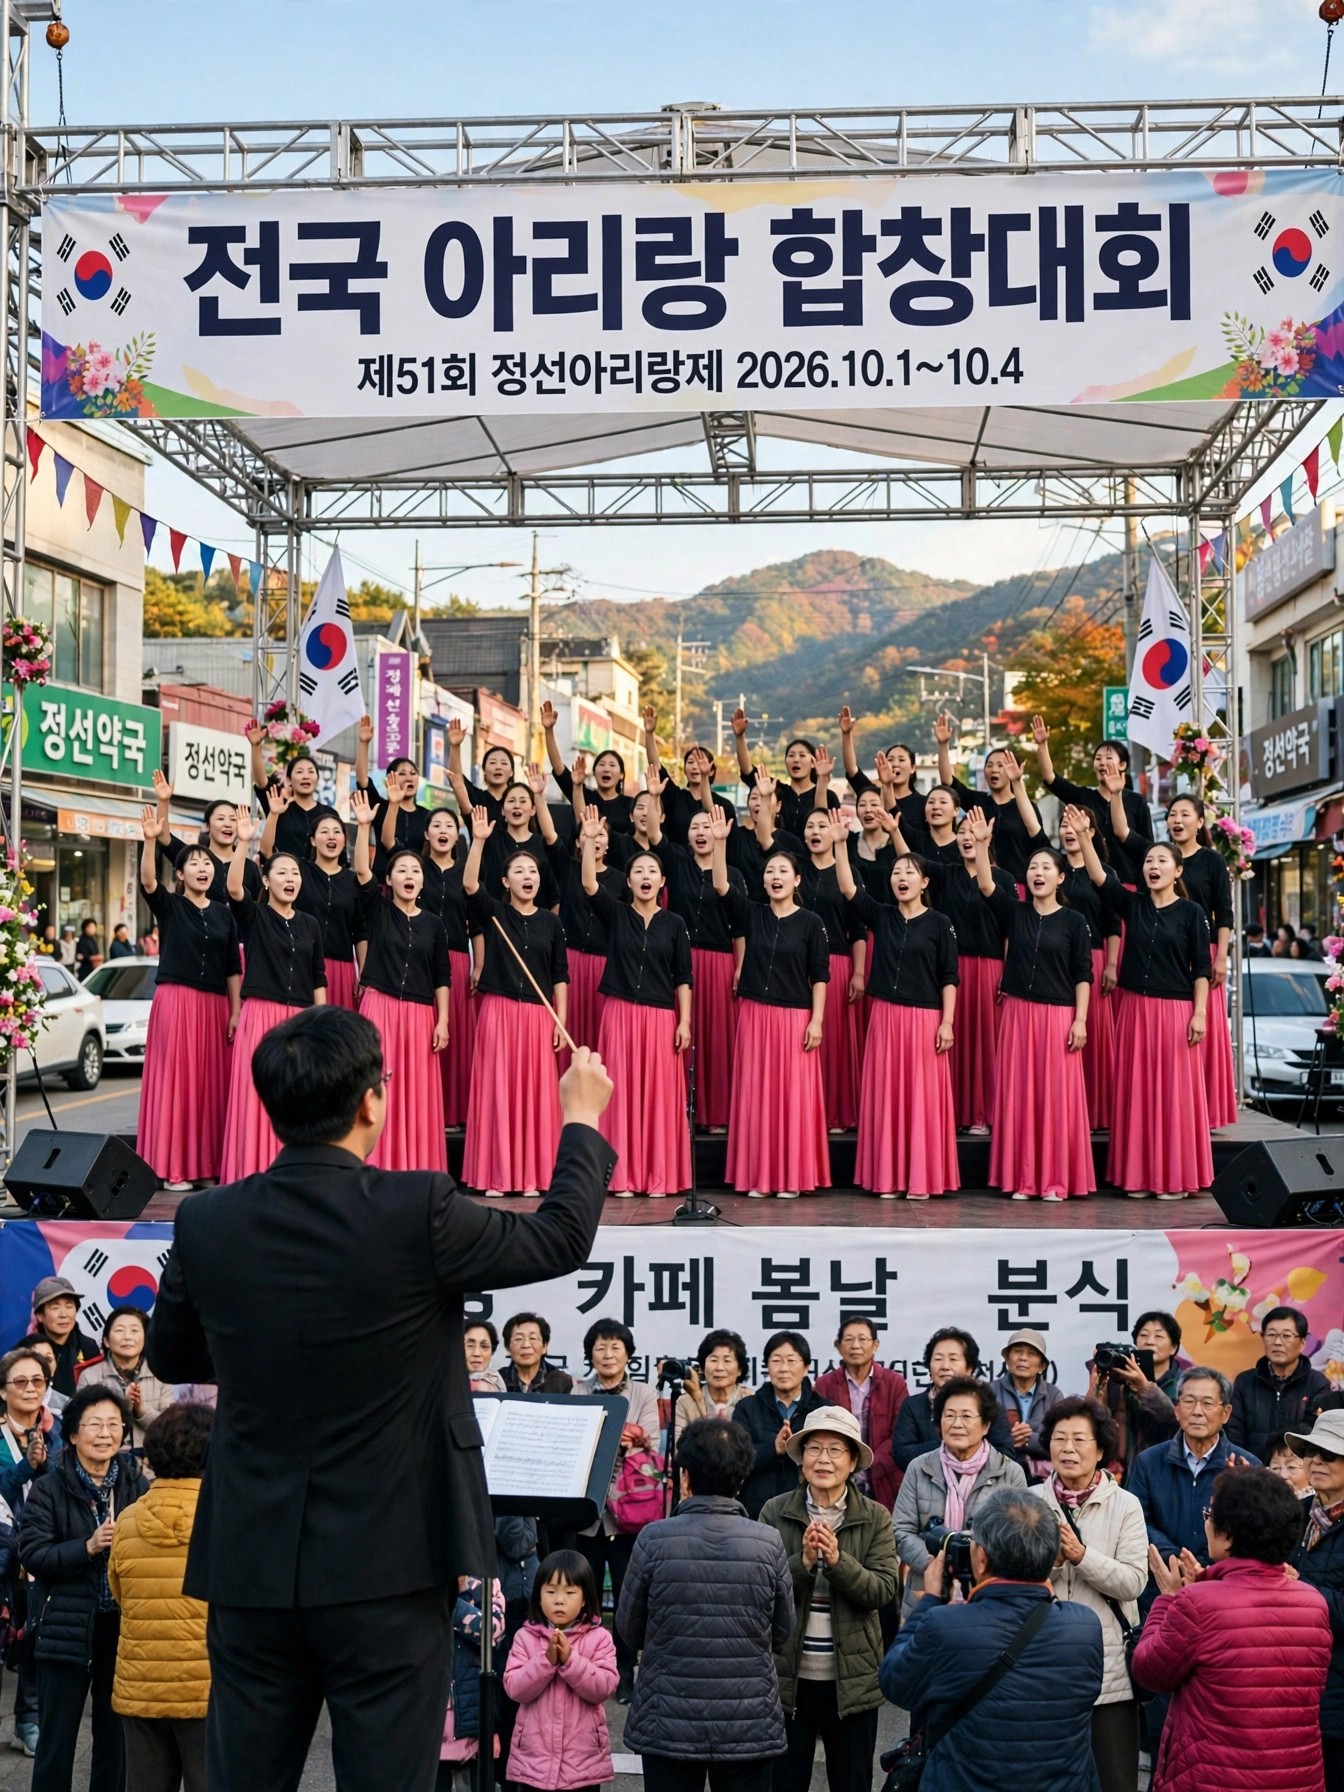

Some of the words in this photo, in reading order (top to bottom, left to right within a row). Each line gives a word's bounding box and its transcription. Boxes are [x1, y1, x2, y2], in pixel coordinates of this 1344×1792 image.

[183, 221, 388, 337] 전국
[425, 213, 739, 333] 아리랑
[771, 203, 1191, 328] 합창대회
[358, 353, 476, 397] 제51회
[492, 350, 723, 395] 정선아리랑제
[737, 347, 1024, 389] 2026.10.1~10.4
[40, 701, 147, 774] 정선약국
[185, 742, 247, 789] 정선약국
[1263, 721, 1310, 779] 정선약국
[576, 1256, 714, 1328] 카페
[752, 1257, 898, 1331] 봄날
[988, 1257, 1130, 1332] 분식
